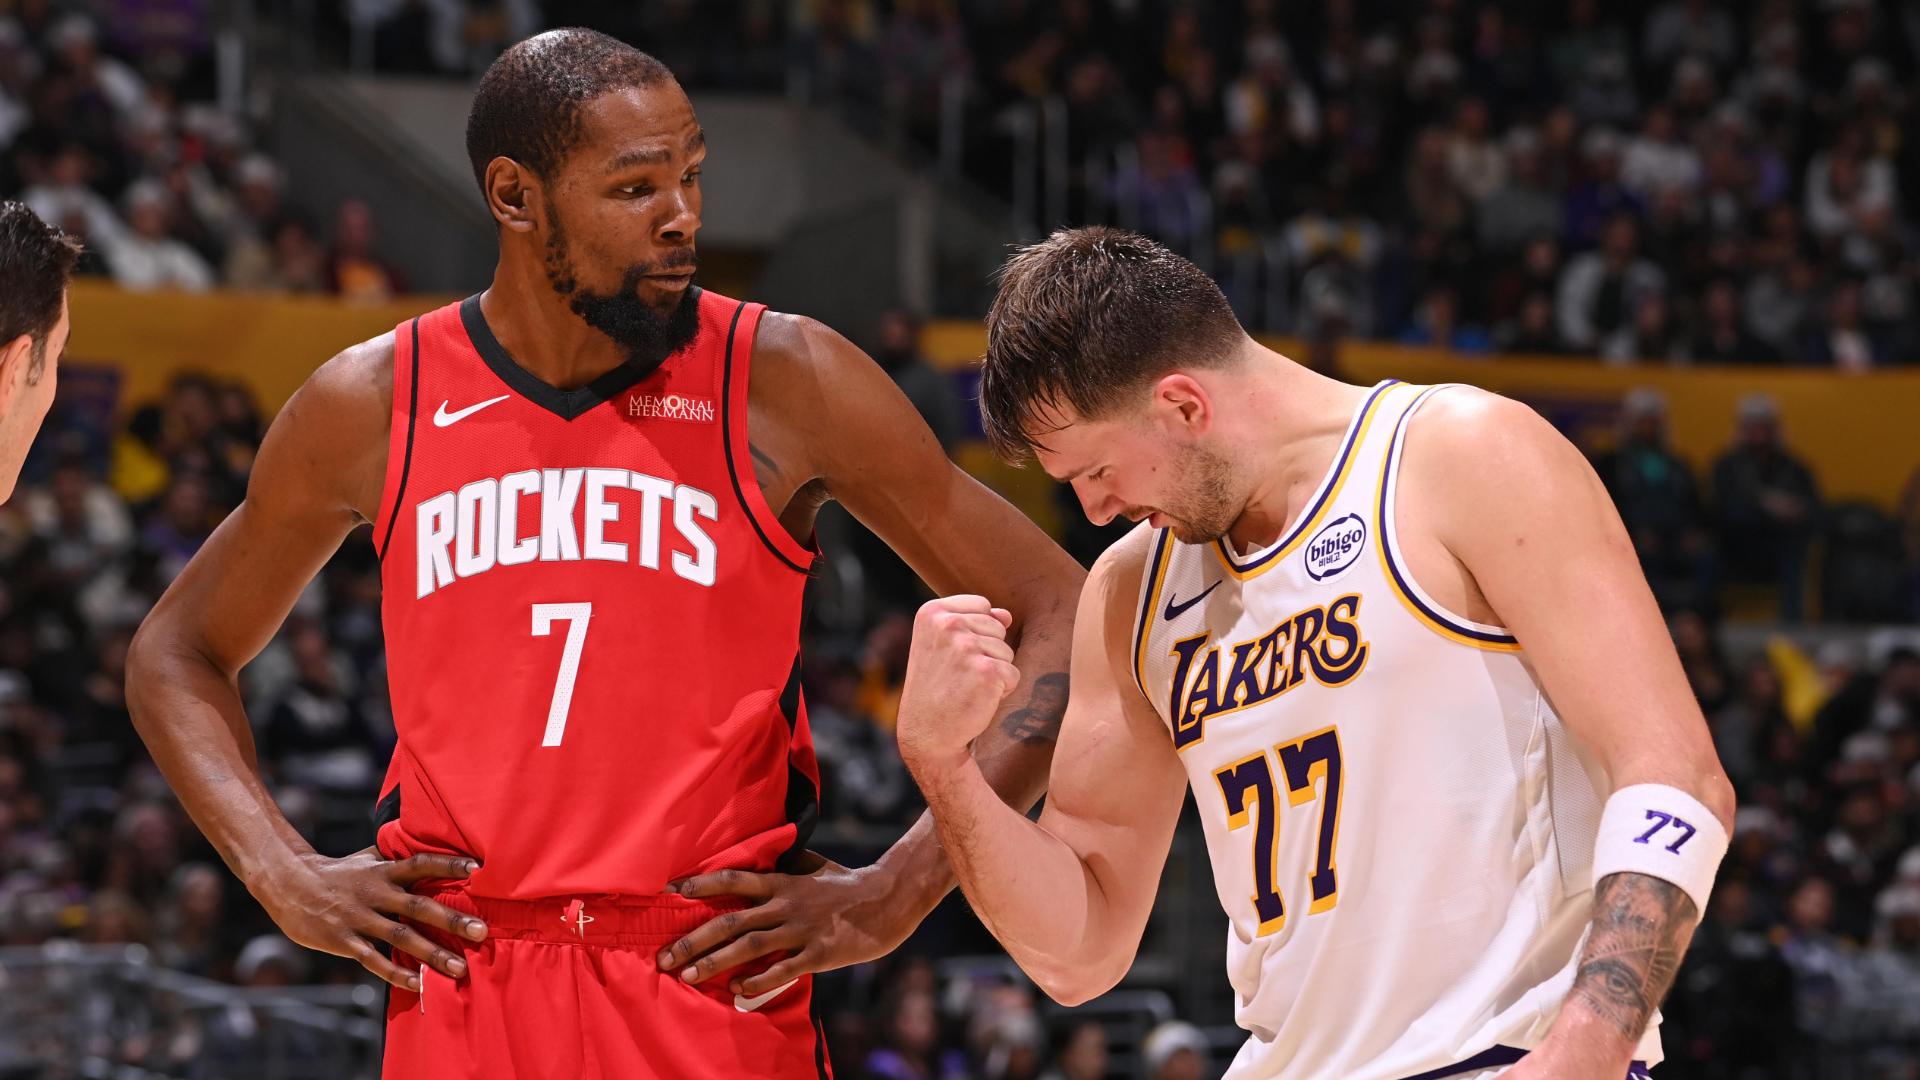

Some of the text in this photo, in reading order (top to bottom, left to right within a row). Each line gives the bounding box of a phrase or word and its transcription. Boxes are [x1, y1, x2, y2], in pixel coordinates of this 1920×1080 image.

[629, 394, 715, 412] MEMORIAL
[629, 405, 714, 421] HERMANN
[416, 467, 718, 600] ROCKETS
[1311, 529, 1362, 562] bibigo
[1318, 552, 1340, 567] 비비고
[531, 602, 592, 747] 7
[1169, 592, 1370, 752] LAKERS
[1211, 724, 1345, 938] 77
[1633, 809, 1697, 856] 77
